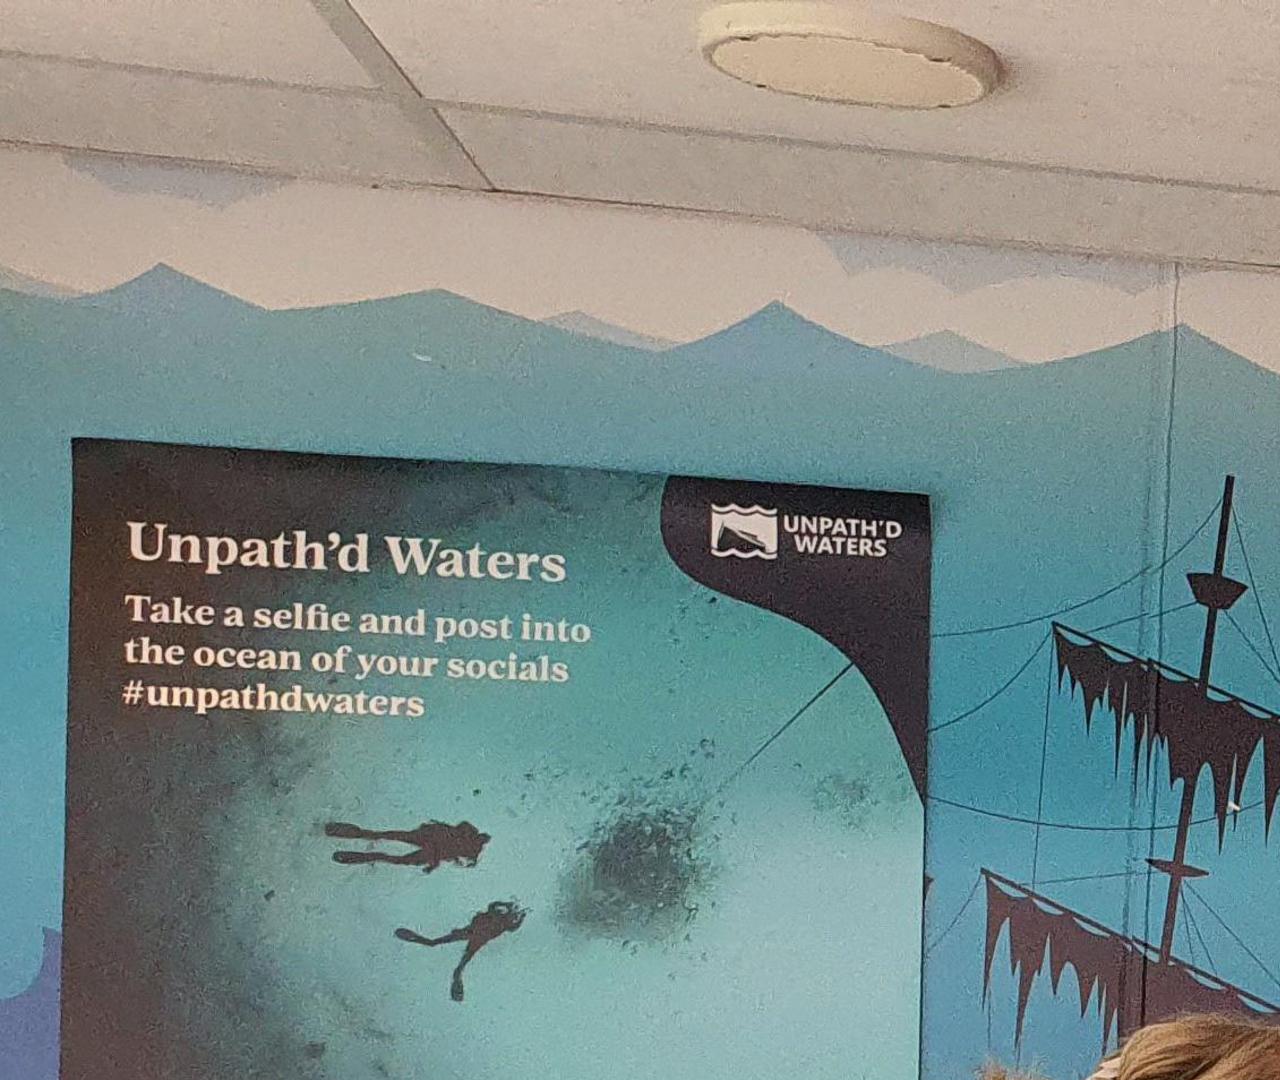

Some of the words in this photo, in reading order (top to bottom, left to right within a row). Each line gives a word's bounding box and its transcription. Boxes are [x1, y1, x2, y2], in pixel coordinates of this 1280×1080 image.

[784, 514, 903, 538] UNPATH'D
[794, 535, 888, 557] WATERS
[126, 521, 370, 575] Unpath'd
[384, 536, 567, 582] Waters
[124, 594, 215, 626] Take
[223, 604, 245, 627] a
[253, 602, 351, 632] selfie
[358, 608, 426, 636] and
[434, 613, 513, 644] post
[521, 612, 592, 643] into
[124, 636, 185, 665] the
[193, 645, 301, 671] ocean
[311, 644, 353, 673] of
[355, 652, 438, 680] your
[446, 651, 570, 682] socials
[121, 679, 425, 717] #unpathdwaters
